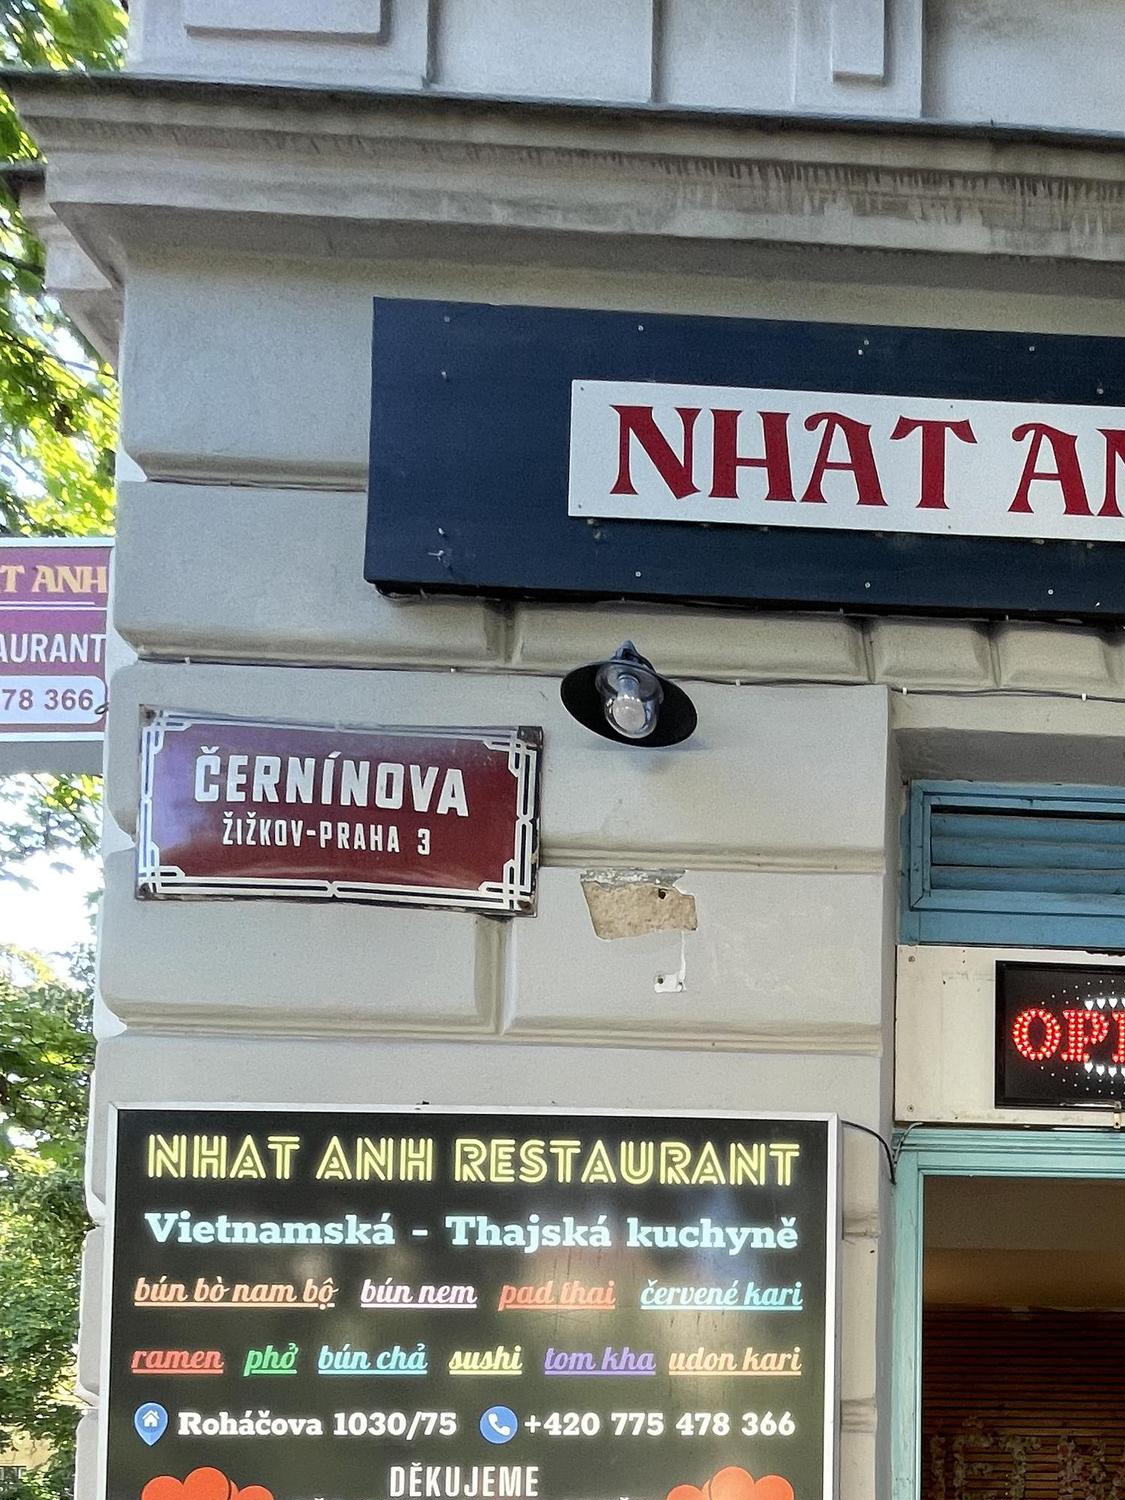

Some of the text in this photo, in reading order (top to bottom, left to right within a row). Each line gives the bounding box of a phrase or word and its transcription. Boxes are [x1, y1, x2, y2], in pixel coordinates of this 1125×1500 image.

[610, 404, 978, 511] NHAT
[31, 565, 108, 593] ANH
[44, 688, 94, 711] 366
[193, 745, 470, 818] ČERNÍNOVA
[222, 811, 431, 856] ŽIŽKOV-PRAHA 3
[148, 1134, 800, 1186] NHAT ANH RESTAURANT
[144, 1210, 396, 1245] Vietnamská
[445, 1214, 613, 1254] Thajská
[626, 1216, 799, 1256] kuchyně
[134, 1275, 340, 1310] bún bò nam bộ
[360, 1278, 478, 1305] bún nem
[498, 1280, 617, 1311] pad thai
[639, 1278, 803, 1306] červené kari
[131, 1350, 225, 1370] ramen
[243, 1342, 299, 1377] phở
[318, 1341, 428, 1370] bún chả
[449, 1345, 523, 1371] sushi
[544, 1347, 656, 1371] tom kha
[668, 1345, 802, 1371] udon kari
[177, 1410, 458, 1442] Roháčova 1030/75
[524, 1411, 796, 1437] +420 775 478 366
[389, 1462, 539, 1498] DĚKUJEME
